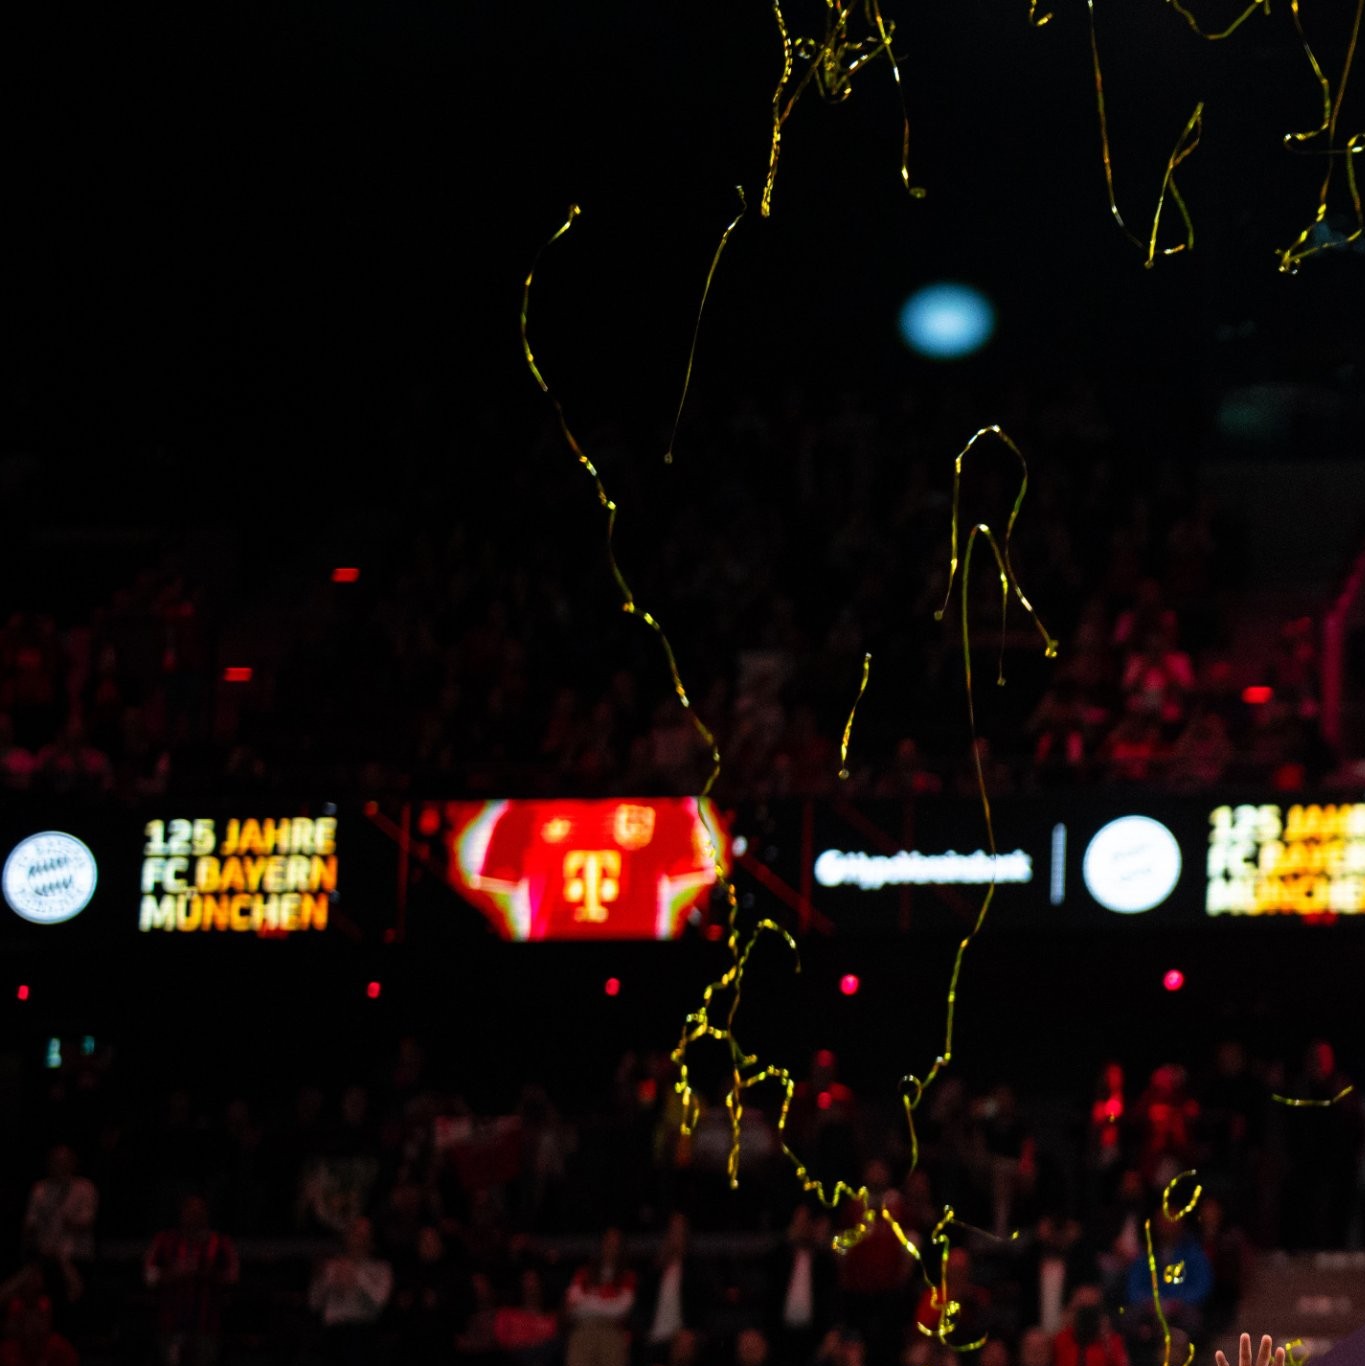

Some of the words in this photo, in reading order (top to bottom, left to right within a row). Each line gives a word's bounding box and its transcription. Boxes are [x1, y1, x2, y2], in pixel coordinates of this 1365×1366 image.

[143, 818, 214, 855] 125
[224, 816, 337, 855] JAHRE
[140, 855, 188, 894] FC
[195, 855, 339, 893] BAYERN
[139, 888, 329, 932] MÜNCHEN
